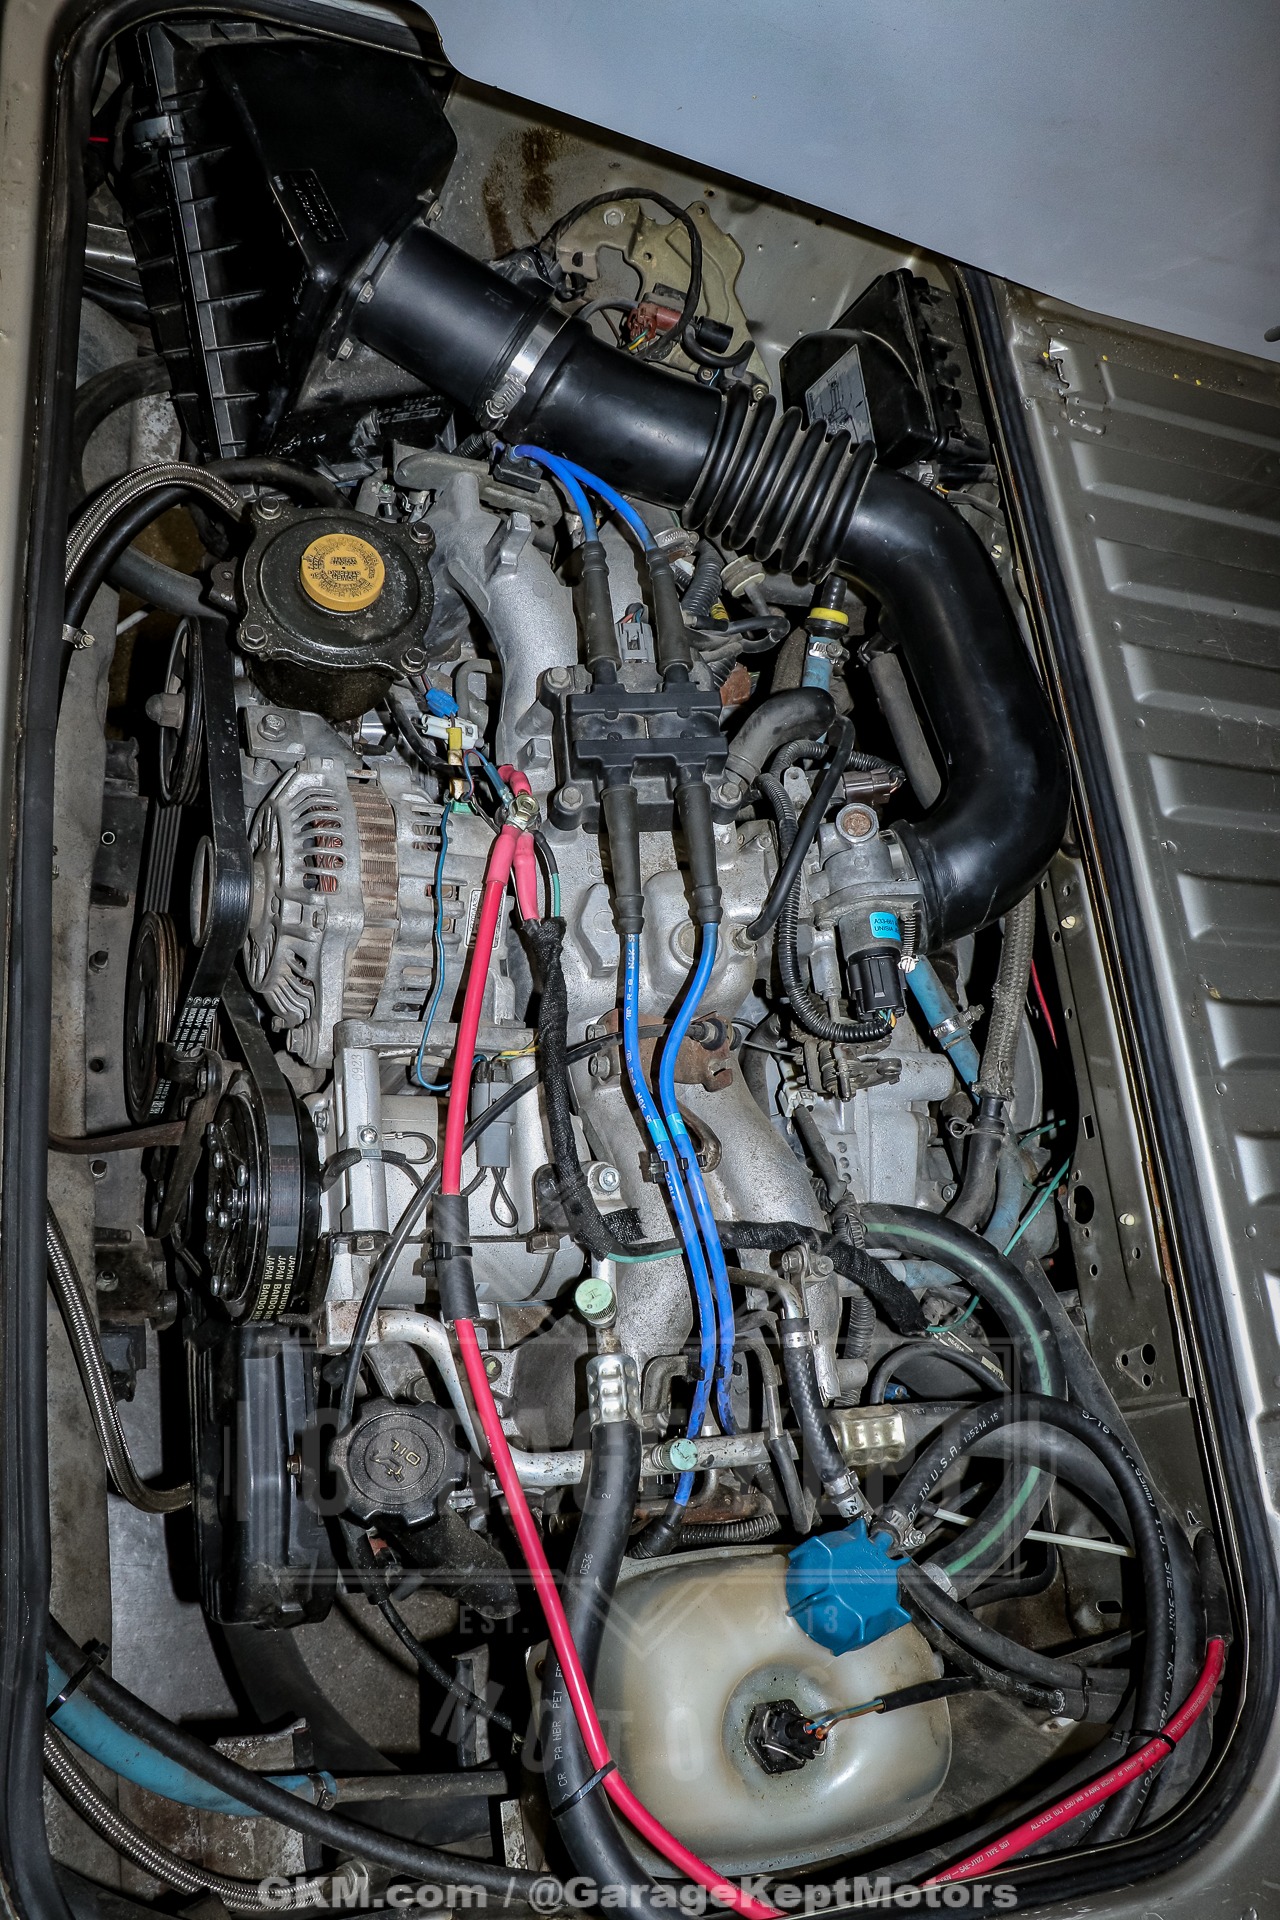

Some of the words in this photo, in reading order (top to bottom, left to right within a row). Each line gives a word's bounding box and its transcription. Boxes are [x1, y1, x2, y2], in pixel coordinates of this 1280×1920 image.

[628, 949, 636, 970] NGK
[351, 1054, 363, 1080] C923
[636, 1091, 646, 1111] NGK
[265, 1255, 276, 1280] JAPAN
[275, 1255, 286, 1280] JAPAN
[257, 1283, 270, 1310] BANDO
[268, 1283, 282, 1310] BANDO
[391, 1440, 421, 1465] OIL
[919, 1482, 930, 1500] IN
[930, 1445, 962, 1481] U.S.A.
[579, 1553, 593, 1575] 0536
[552, 1690, 563, 1709] PET
[552, 1720, 562, 1741] NBR
[553, 1746, 564, 1760] PA
[557, 1771, 568, 1787] CR
[985, 1846, 999, 1858] TYPE
